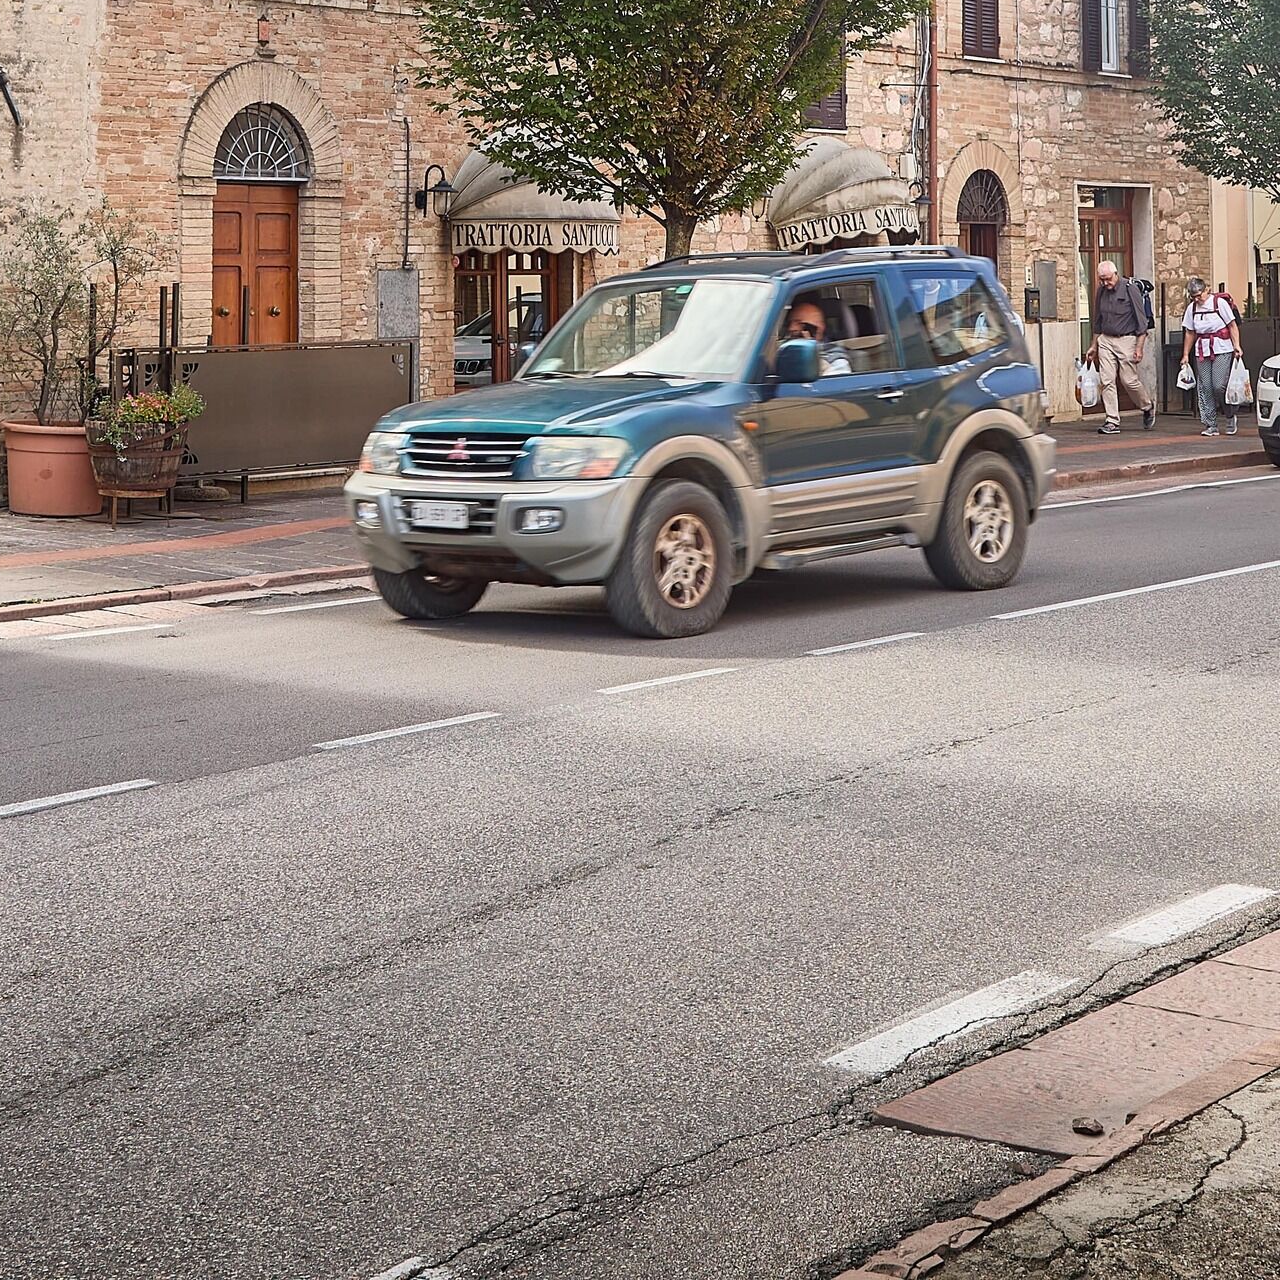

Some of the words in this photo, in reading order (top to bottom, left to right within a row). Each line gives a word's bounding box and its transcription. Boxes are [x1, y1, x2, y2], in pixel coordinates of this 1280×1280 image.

[453, 223, 553, 247] TRATTORIA
[562, 223, 614, 247] SANTUCCI
[777, 211, 867, 247] TRATTORIA
